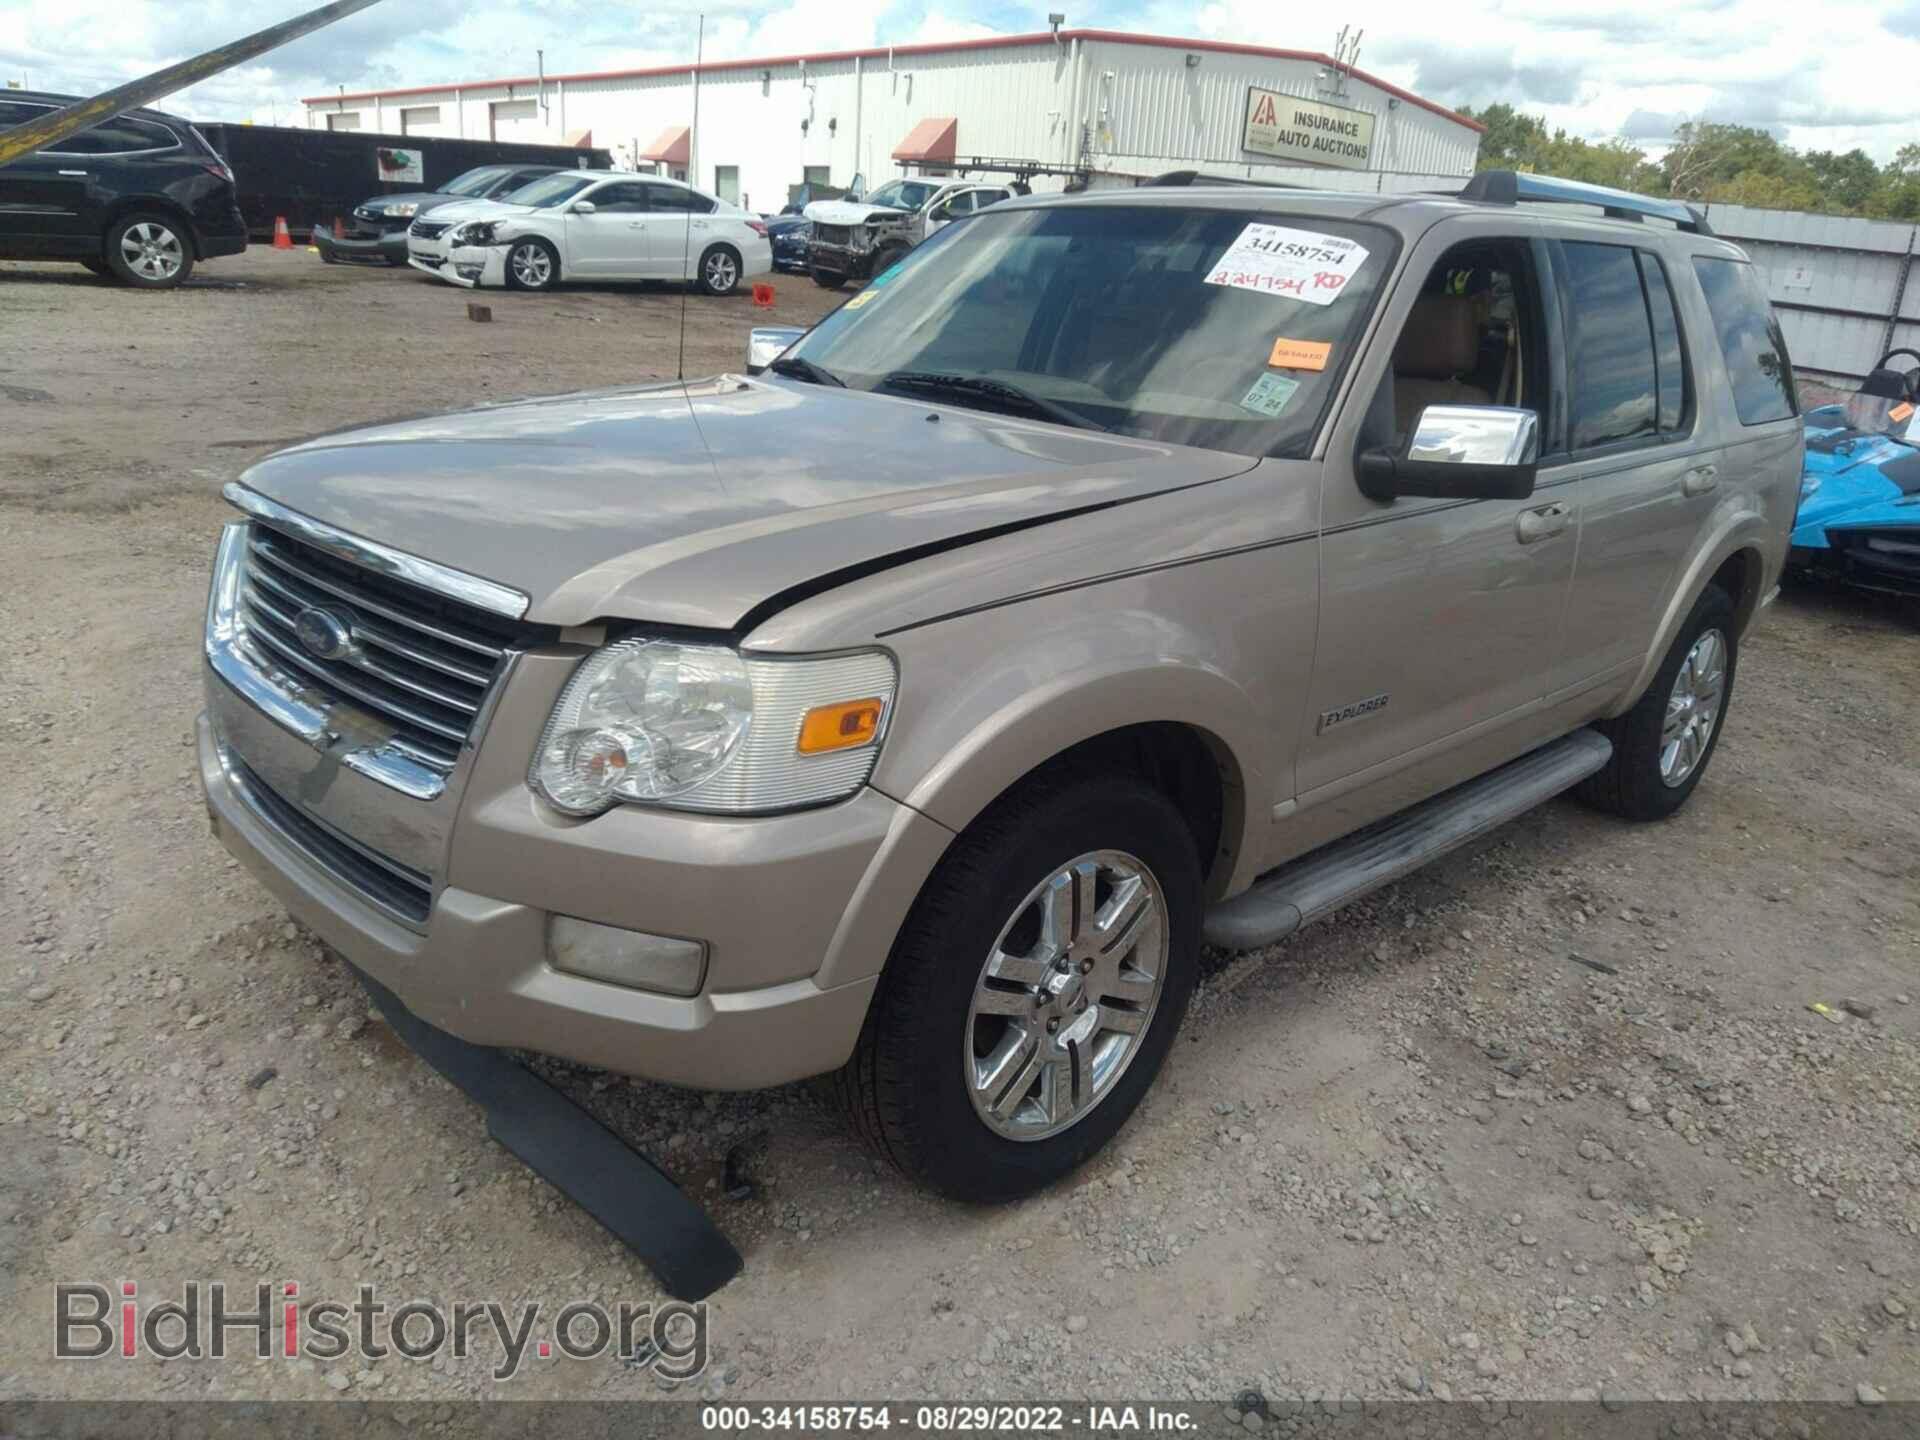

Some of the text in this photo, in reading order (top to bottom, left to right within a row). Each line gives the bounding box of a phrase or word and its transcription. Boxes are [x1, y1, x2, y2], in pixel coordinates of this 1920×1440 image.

[1293, 110, 1360, 137] INSURANCE
[1277, 129, 1369, 160] AUTO AUCTIONS
[1245, 237, 1347, 265] 34158754
[1324, 694, 1389, 728] EXPLORER
